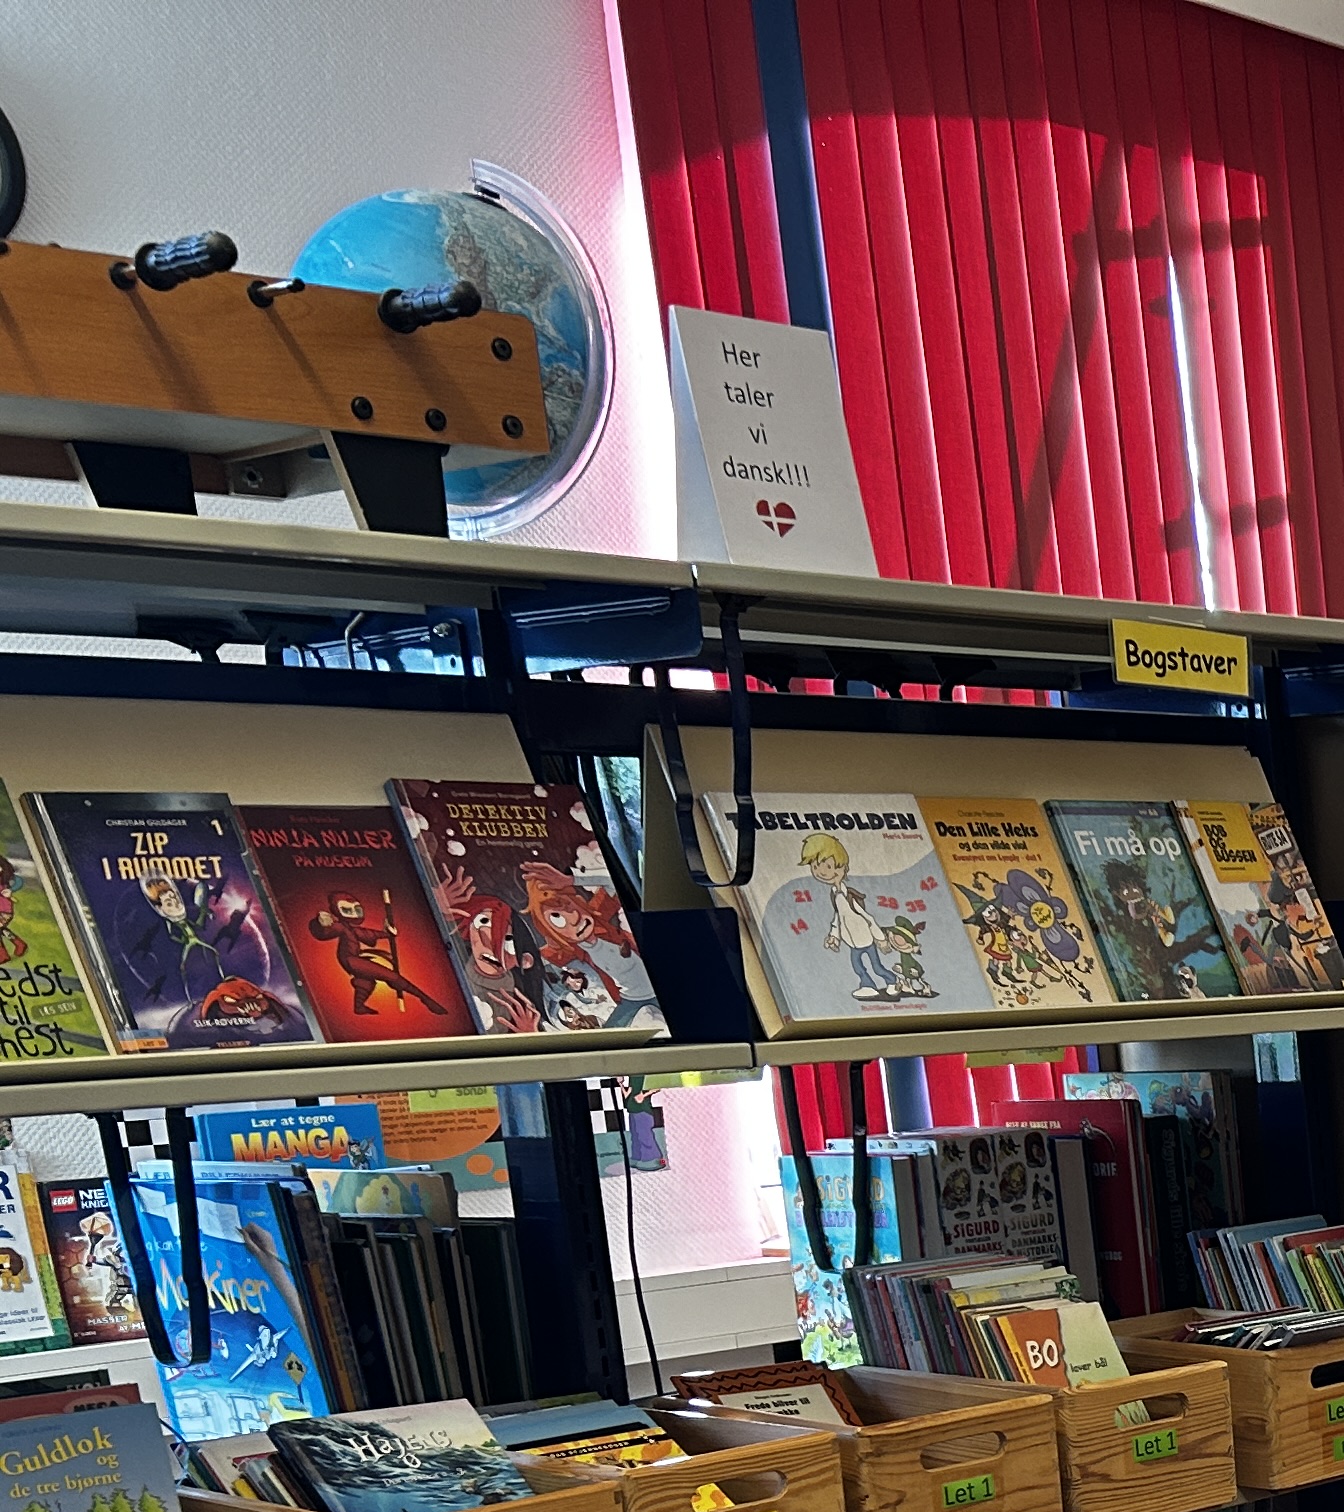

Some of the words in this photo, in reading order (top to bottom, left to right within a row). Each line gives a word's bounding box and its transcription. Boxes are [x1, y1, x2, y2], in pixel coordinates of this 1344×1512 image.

[721, 341, 761, 369] Her
[724, 382, 775, 409] taler
[747, 422, 768, 445] vi
[722, 455, 811, 488] dansk!!!
[1124, 638, 1238, 678] Bogstaver
[446, 803, 548, 821] DETEKTIV
[210, 819, 224, 837] 1
[459, 821, 549, 838] KLUBBEN
[934, 821, 966, 837] Den
[966, 822, 1001, 837] Lille
[1000, 822, 1039, 838] Heks
[1203, 824, 1228, 838] BOB
[130, 832, 170, 855] ZIP
[250, 829, 319, 849] NINJA
[321, 829, 399, 850] NILLER
[958, 841, 972, 852] og
[972, 840, 990, 850] den
[1073, 830, 1101, 856] Fi
[1104, 828, 1146, 856] må
[1150, 835, 1182, 862] op
[1208, 837, 1226, 850] OG
[101, 856, 112, 880] I
[118, 855, 223, 880] RUMMET
[315, 855, 373, 868] MUSEUM
[919, 875, 938, 892] 42
[792, 890, 813, 903] 21
[905, 899, 927, 913] 35
[251, 1115, 276, 1129] Lær
[280, 1115, 295, 1127] at
[299, 1113, 336, 1127] tegne
[230, 1126, 351, 1162] MANGA
[51, 1196, 75, 1207] LEGO
[78, 1188, 108, 1201] NE
[1025, 1338, 1059, 1370] BO
[744, 1402, 771, 1410] Frede
[0, 1426, 114, 1476] Guldlok
[1135, 1435, 1163, 1457] Let
[1166, 1431, 1176, 1450] 1
[96, 1453, 119, 1469] og
[9, 1483, 31, 1498] de
[36, 1481, 60, 1494] tre
[64, 1473, 122, 1493] bjørne
[944, 1484, 975, 1506] Let
[982, 1477, 993, 1497] 1
